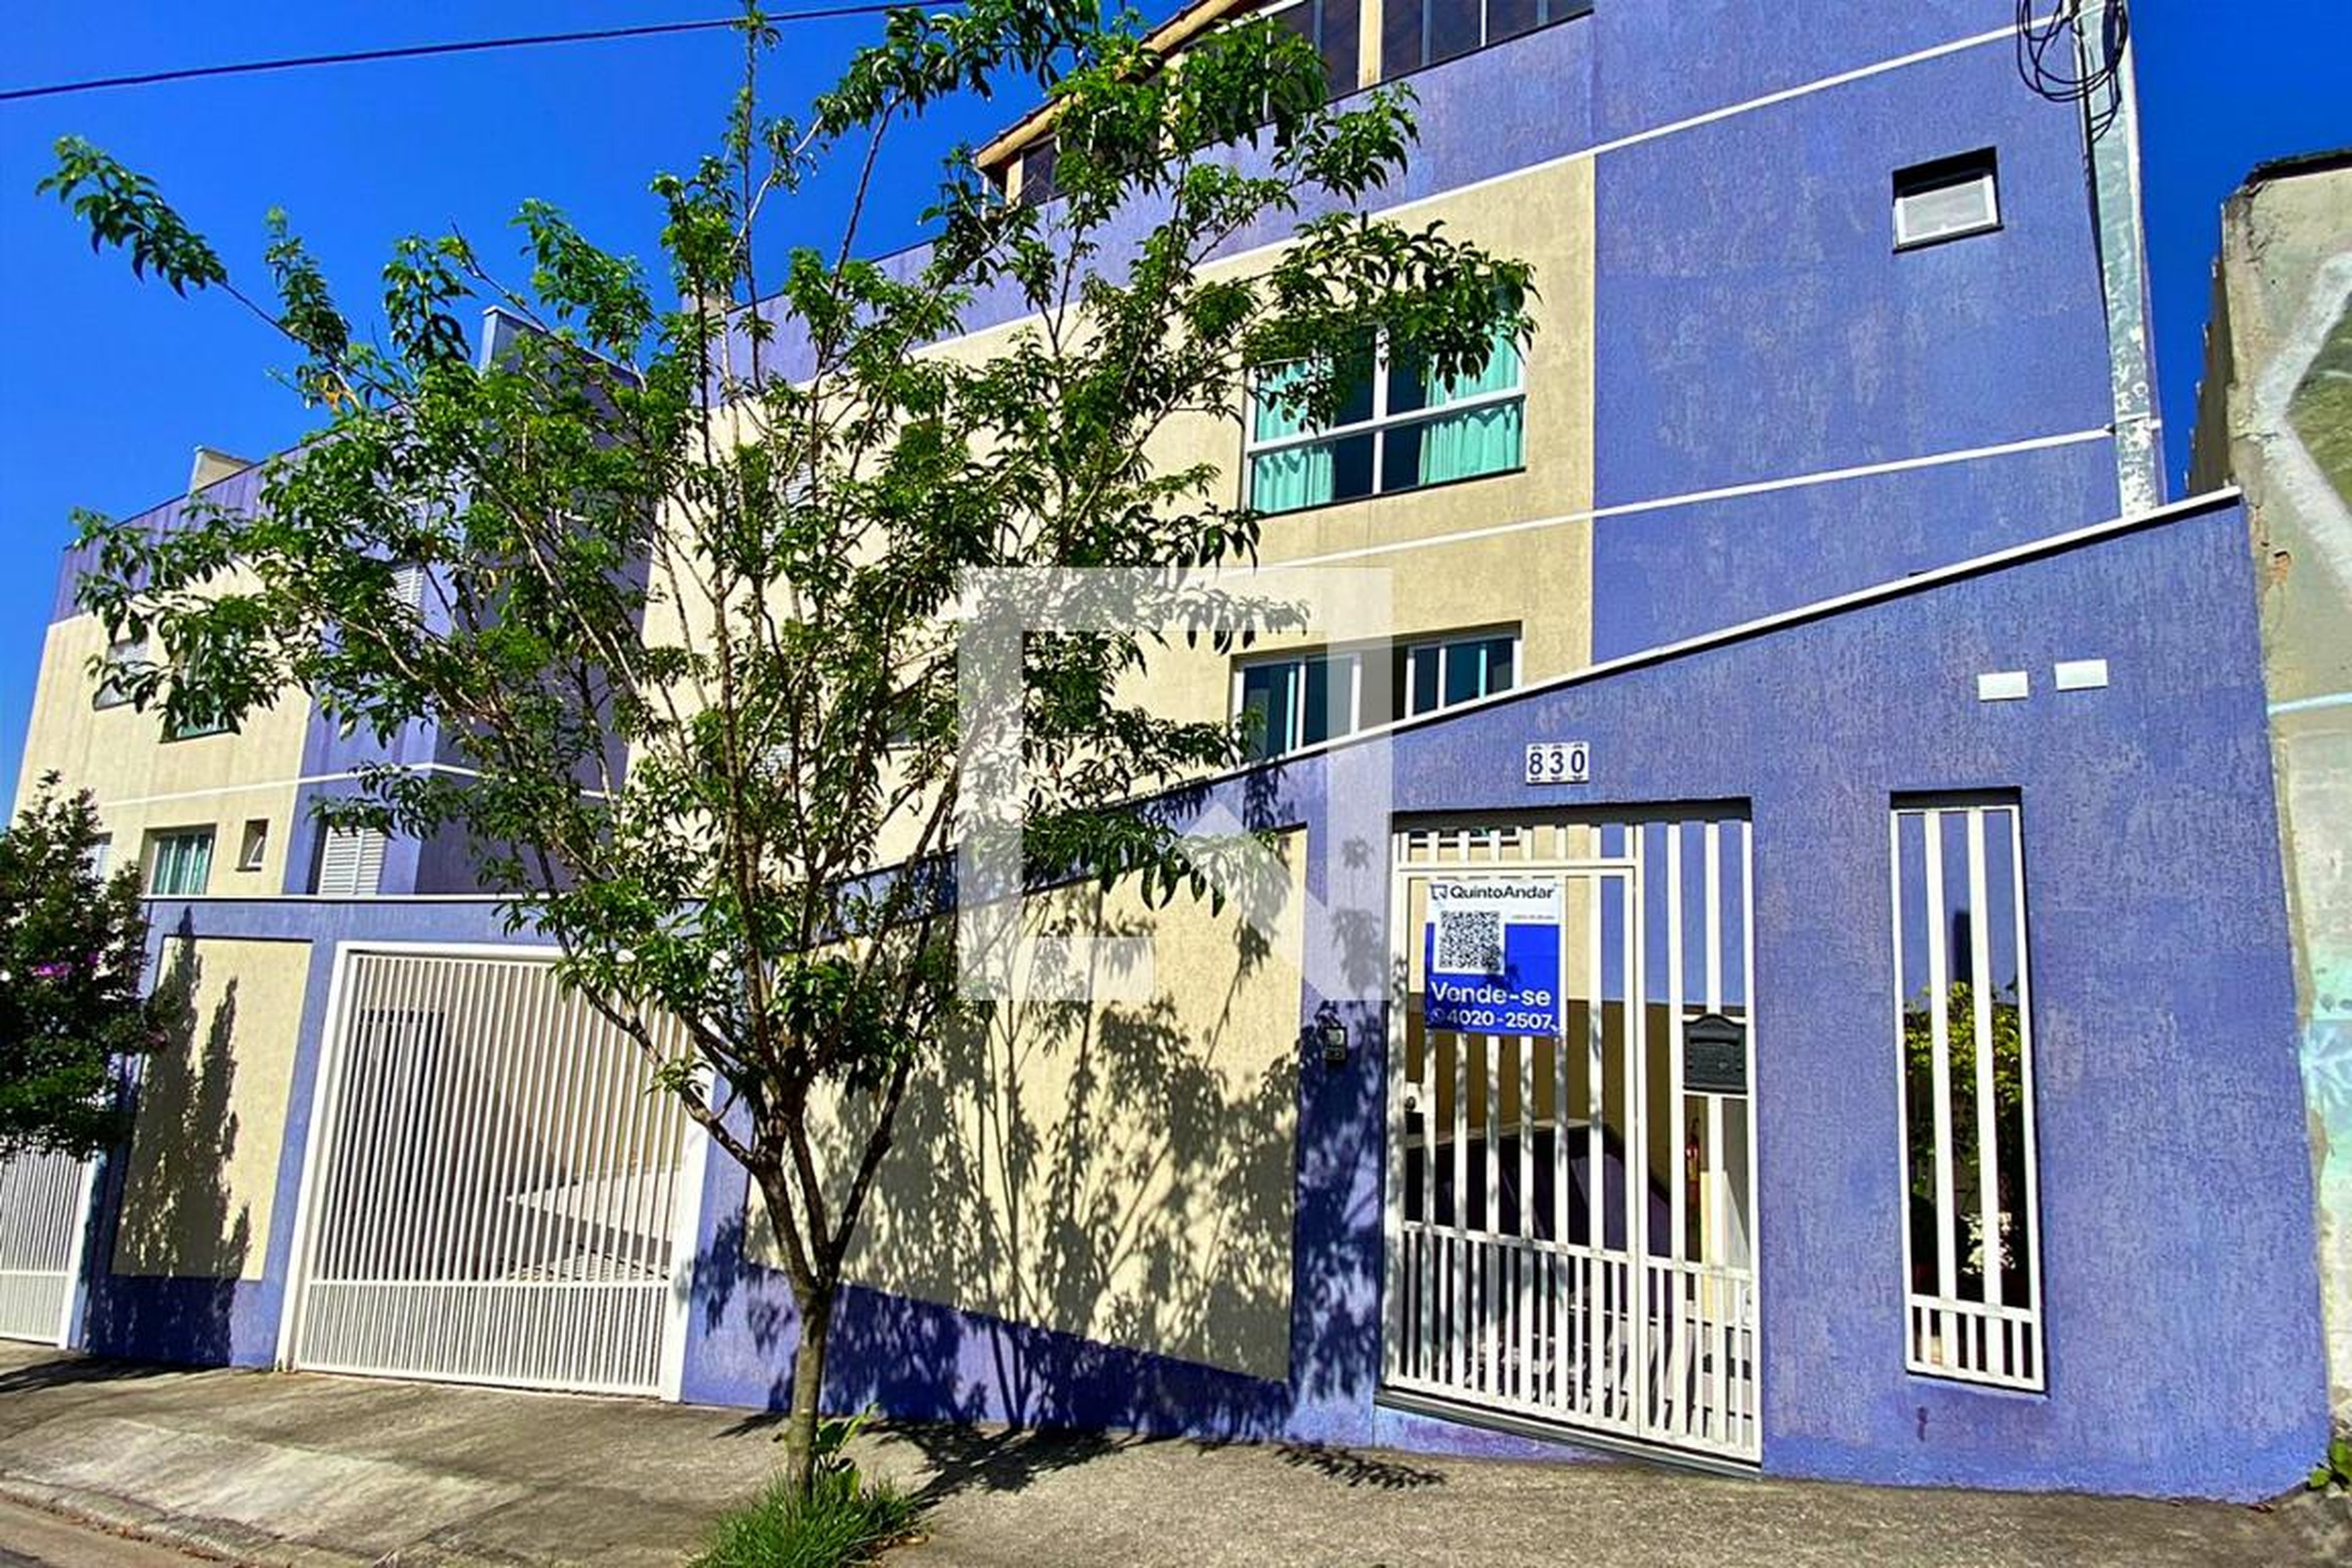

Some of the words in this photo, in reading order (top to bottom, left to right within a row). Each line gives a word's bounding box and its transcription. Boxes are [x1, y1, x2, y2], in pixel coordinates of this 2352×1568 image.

[1529, 749, 1585, 775] 830
[1450, 885, 1555, 899] QuintoAndar
[1431, 981, 1551, 1006] Vende-se
[1447, 1009, 1553, 1030] 4020-2507
